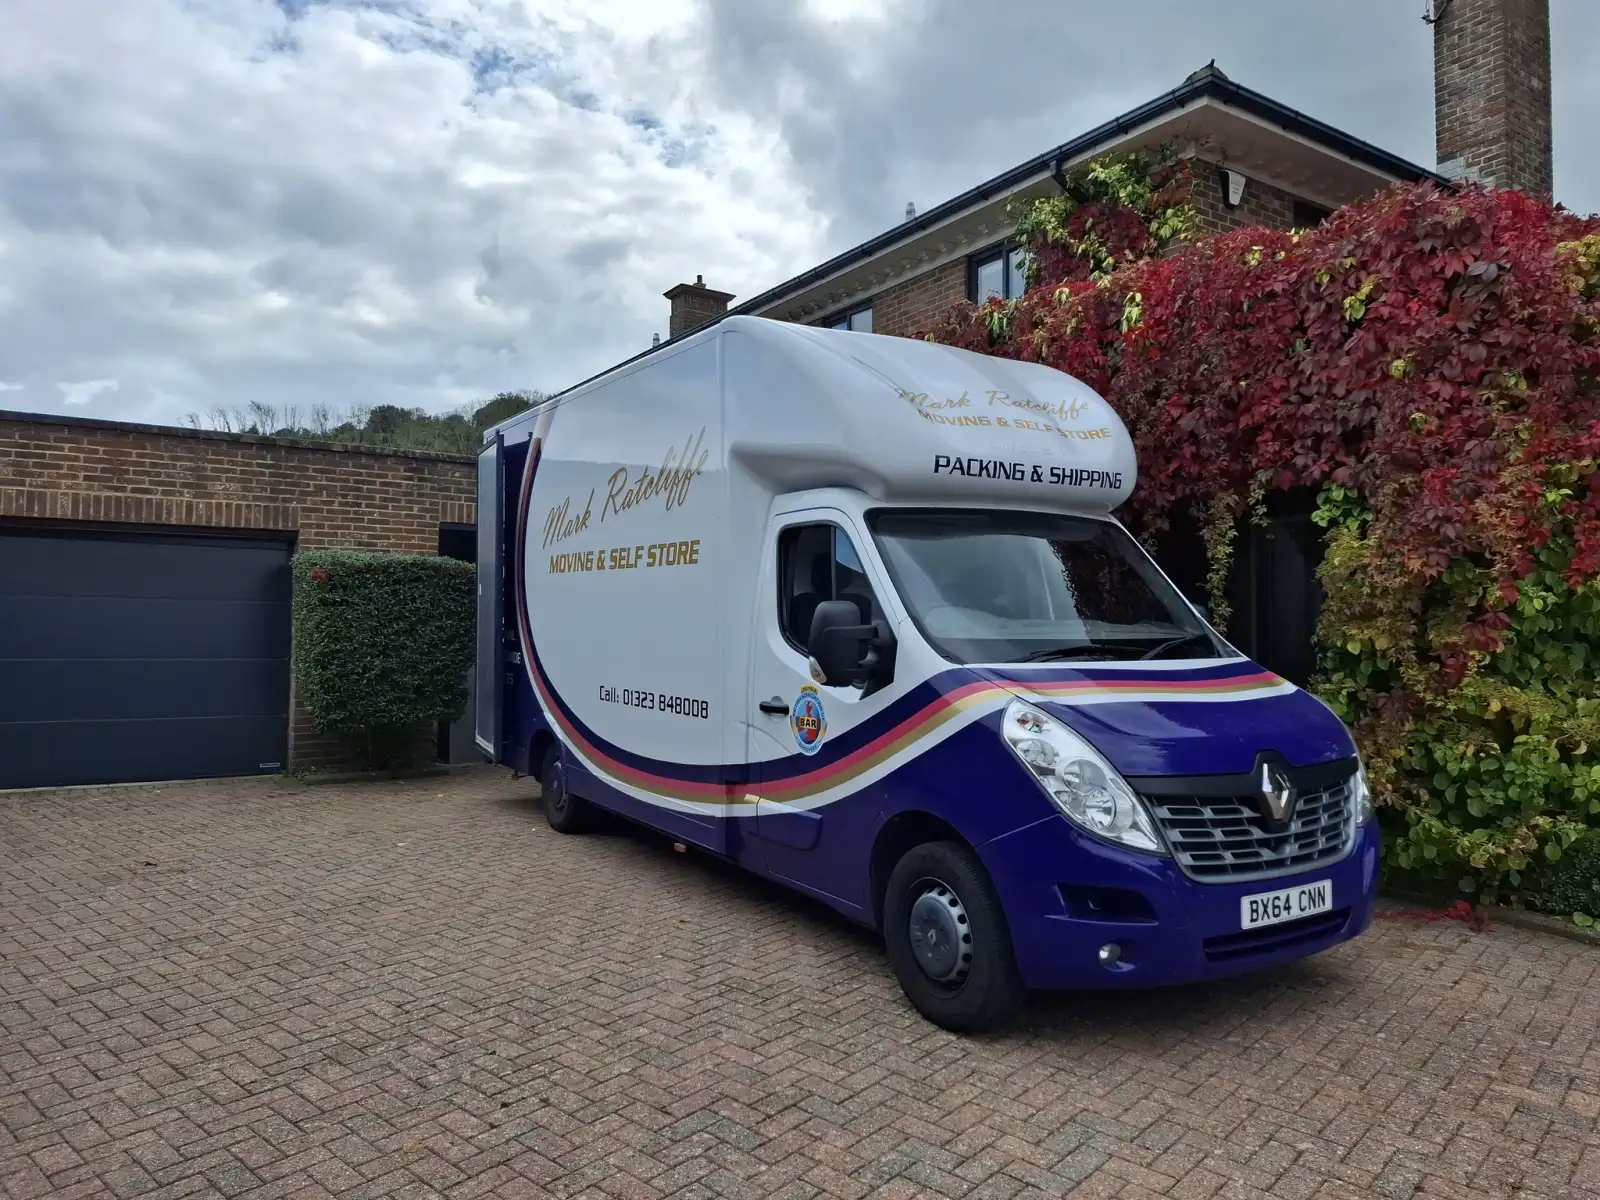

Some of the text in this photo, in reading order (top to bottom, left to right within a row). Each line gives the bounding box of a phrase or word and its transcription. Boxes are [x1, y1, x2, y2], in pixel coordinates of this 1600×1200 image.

[894, 387, 971, 409] Mark
[916, 408, 1112, 441] MOVING & SELF STORE
[933, 454, 1122, 490] PACKING & SHIPPING
[542, 487, 595, 549] Mark
[549, 539, 700, 574] MOVING & SELF STORE
[599, 685, 709, 719] Call: 01323 848008
[800, 718, 817, 729] BAR
[1249, 885, 1326, 923] BX64 CNN
